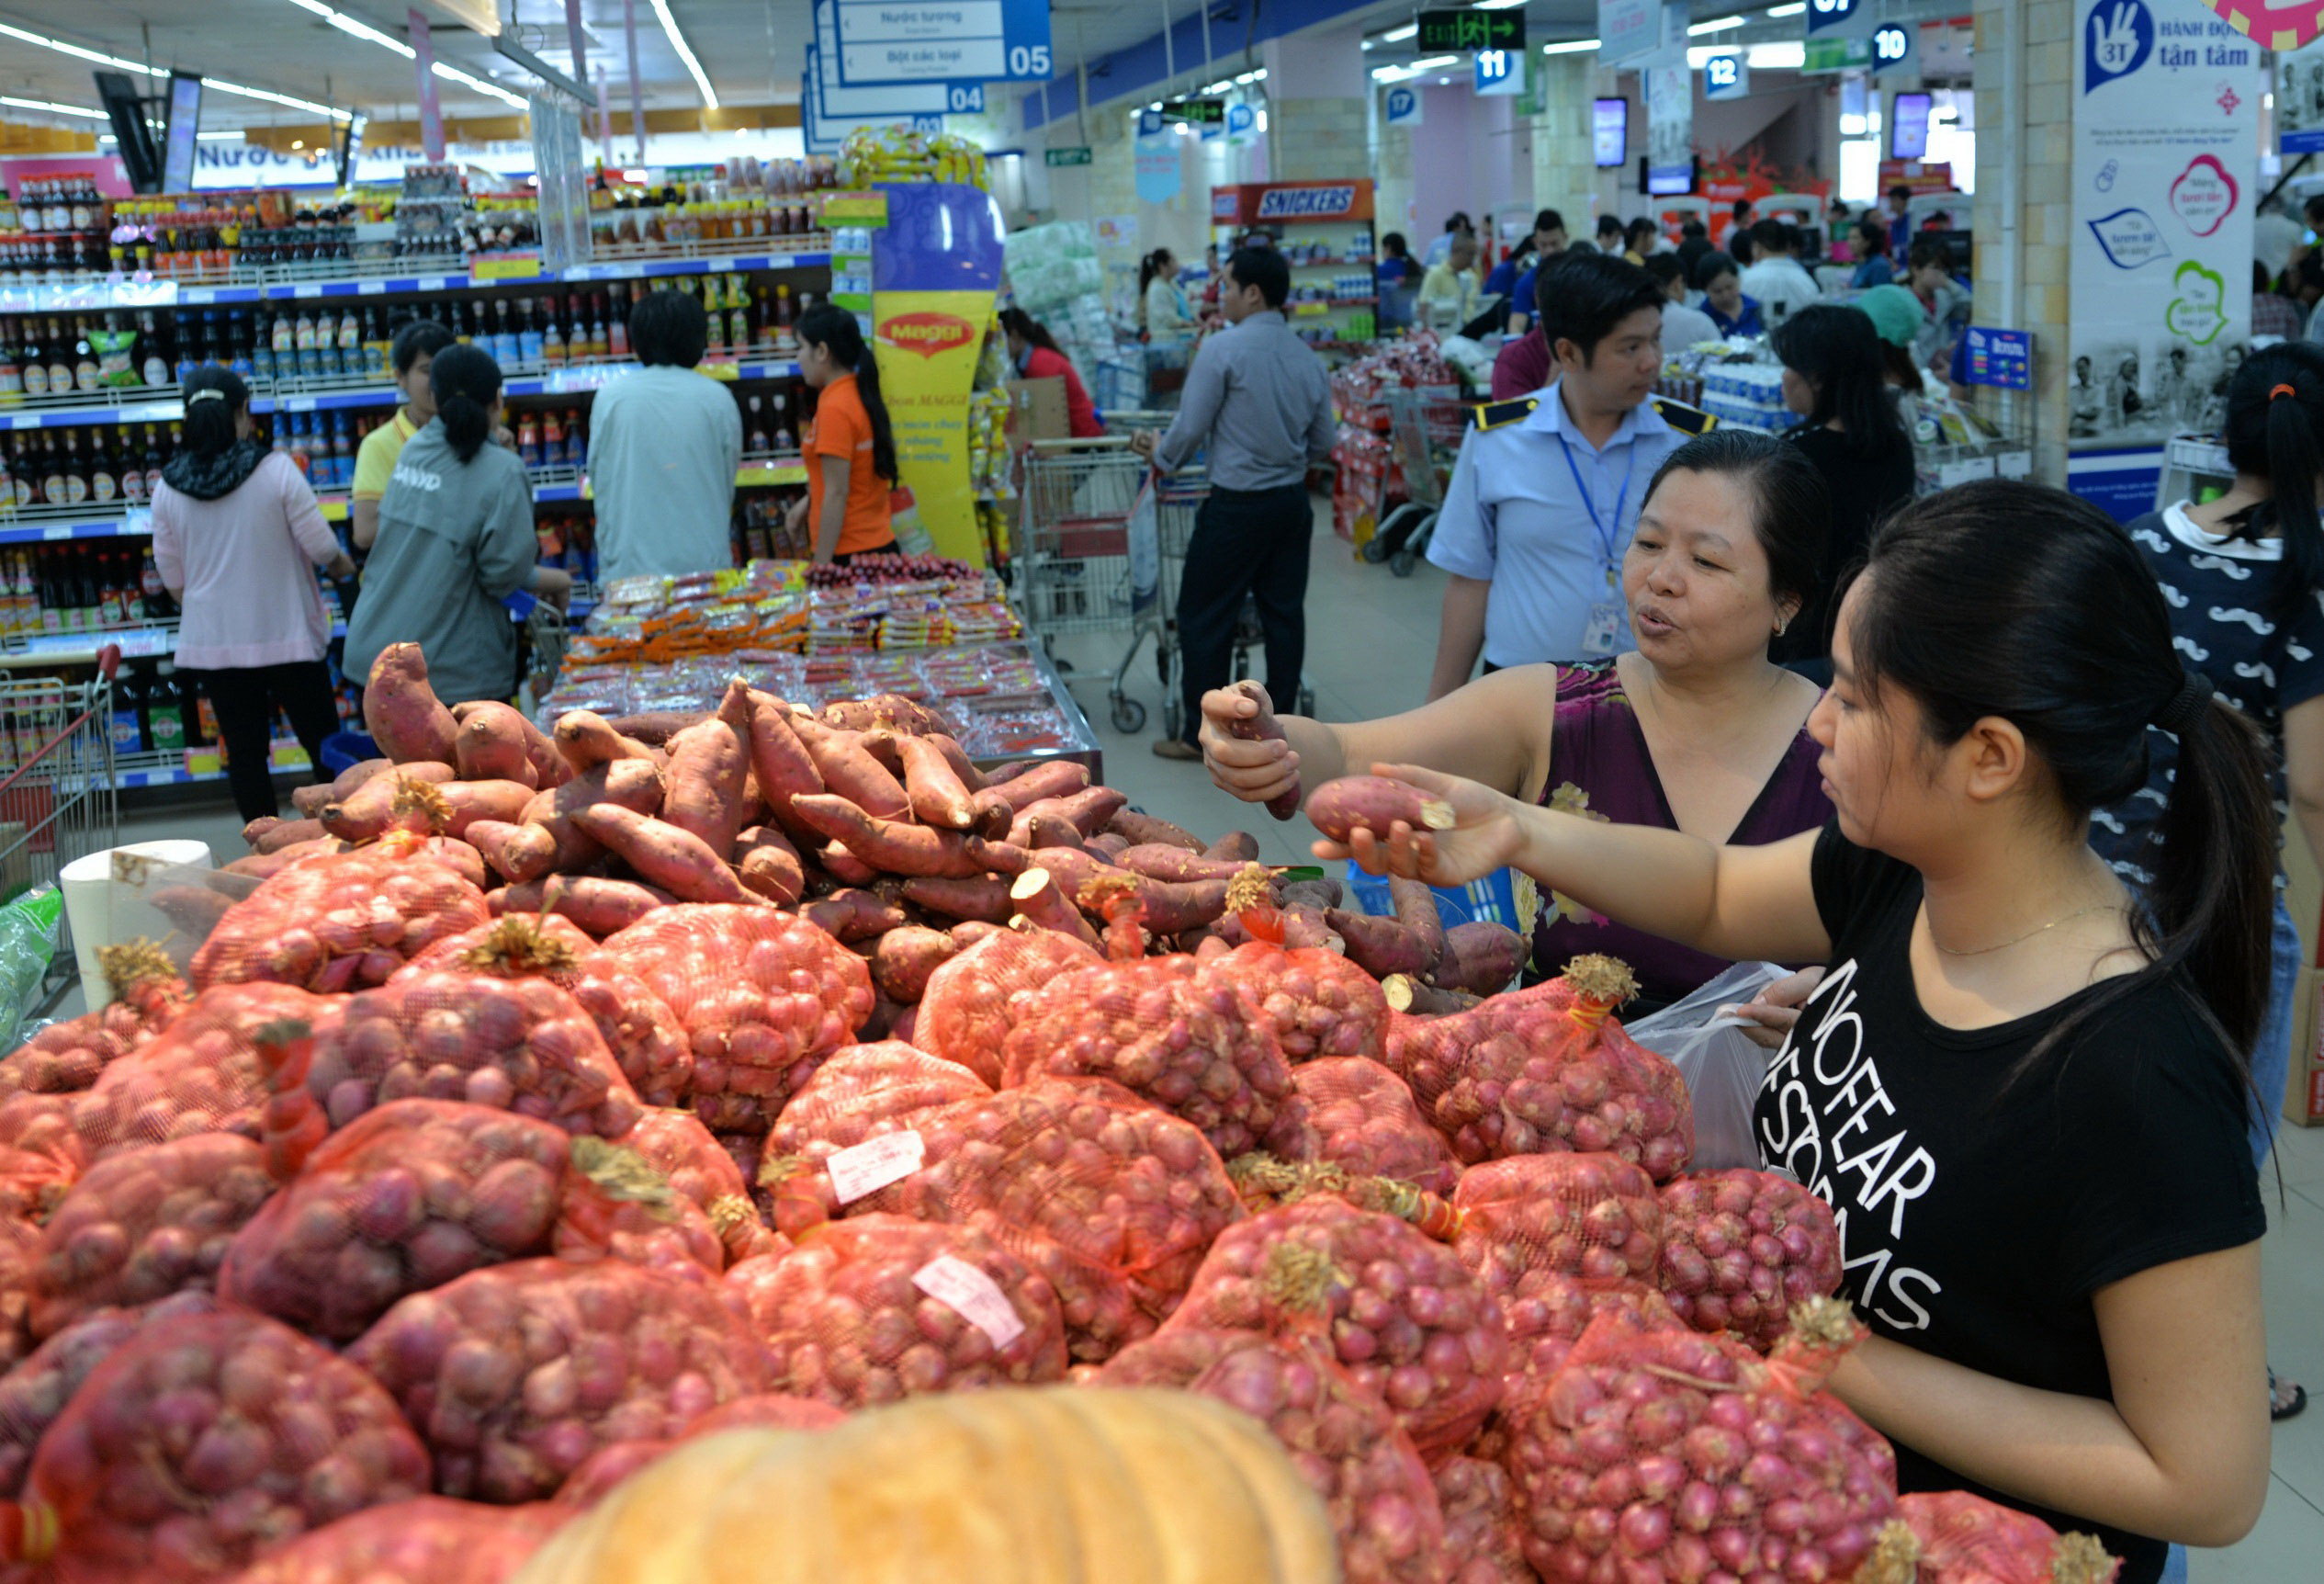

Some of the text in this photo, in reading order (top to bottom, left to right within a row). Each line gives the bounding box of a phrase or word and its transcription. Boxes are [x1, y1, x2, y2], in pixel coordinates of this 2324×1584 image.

[1874, 29, 1906, 60] 10
[2103, 42, 2130, 63] 3T
[2160, 44, 2249, 72] tận tâm
[1010, 46, 1051, 76] 05
[1478, 50, 1506, 78] 11
[1708, 59, 1737, 85] 12
[950, 87, 983, 111] 04
[1392, 93, 1411, 112] 17
[1261, 187, 1354, 215] SNICKERS
[890, 323, 964, 343] Maggi
[1806, 957, 1937, 1241] NO FEAR
